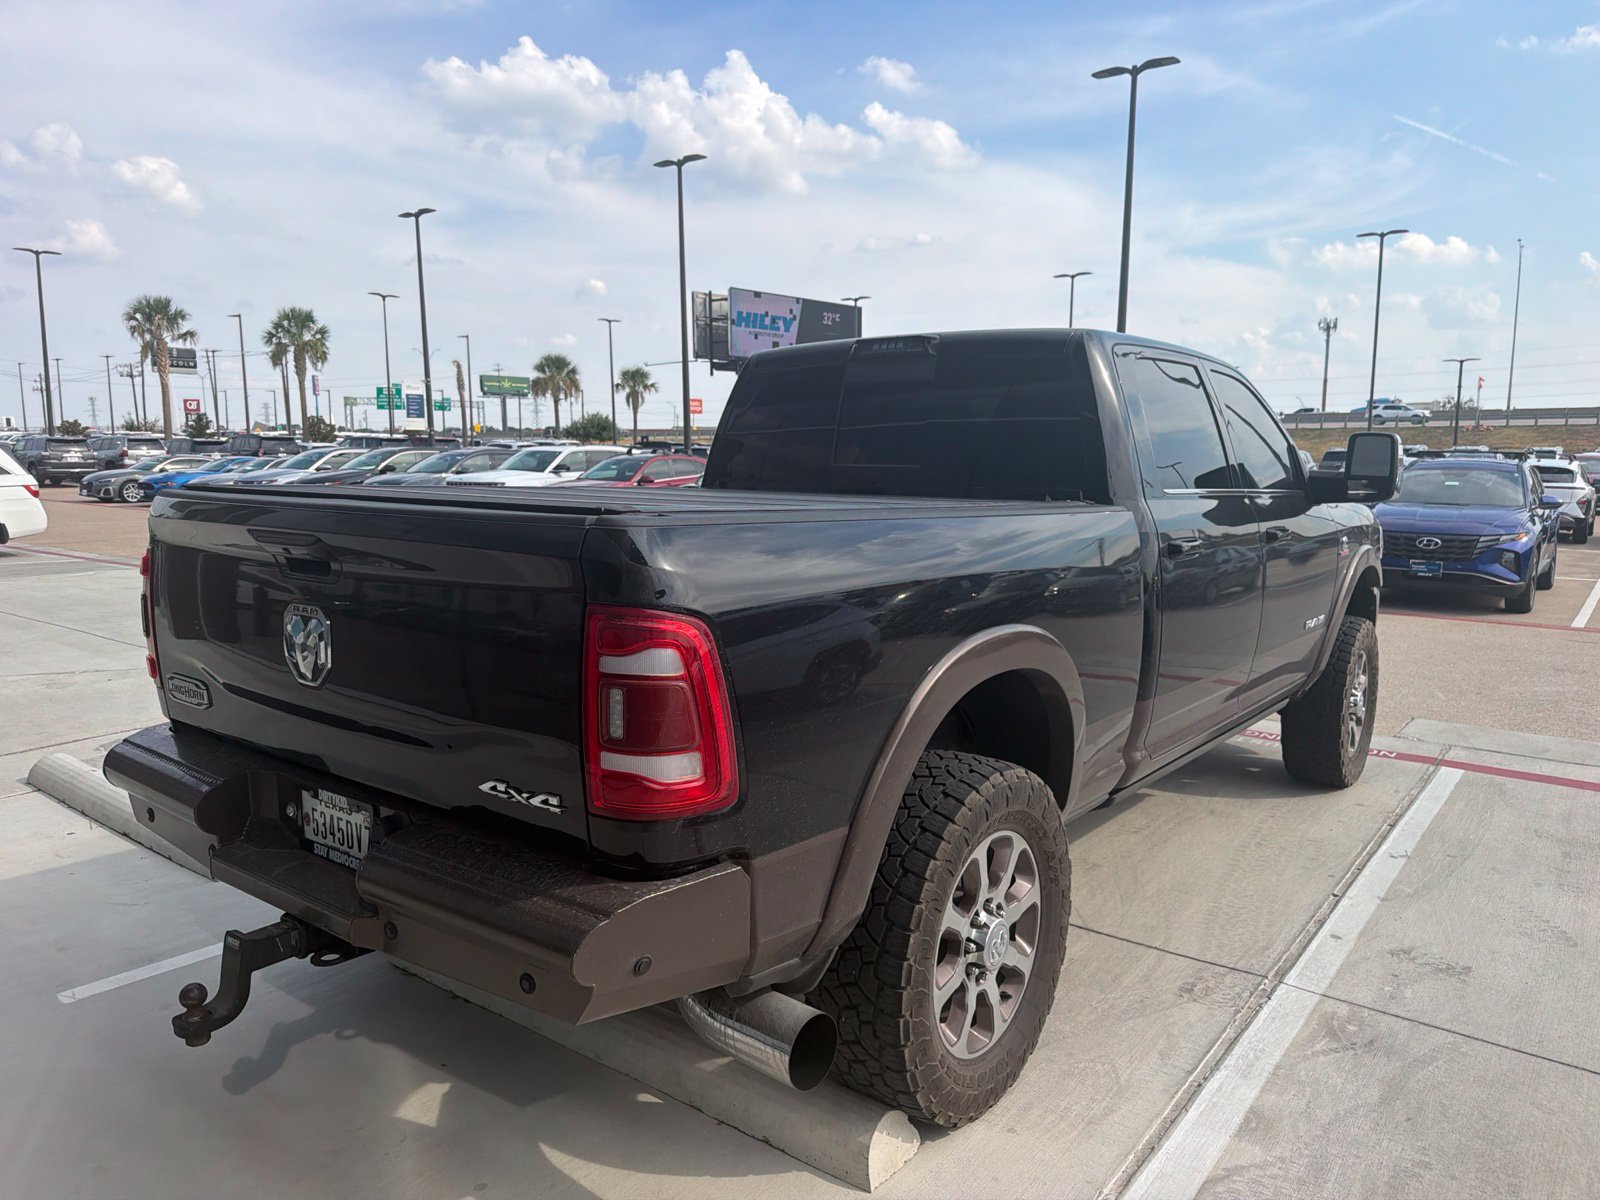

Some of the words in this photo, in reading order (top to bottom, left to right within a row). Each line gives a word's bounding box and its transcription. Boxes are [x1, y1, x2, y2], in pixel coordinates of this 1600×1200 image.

[736, 310, 795, 333] HILEY
[186, 400, 198, 410] QT
[292, 605, 318, 615] RAM
